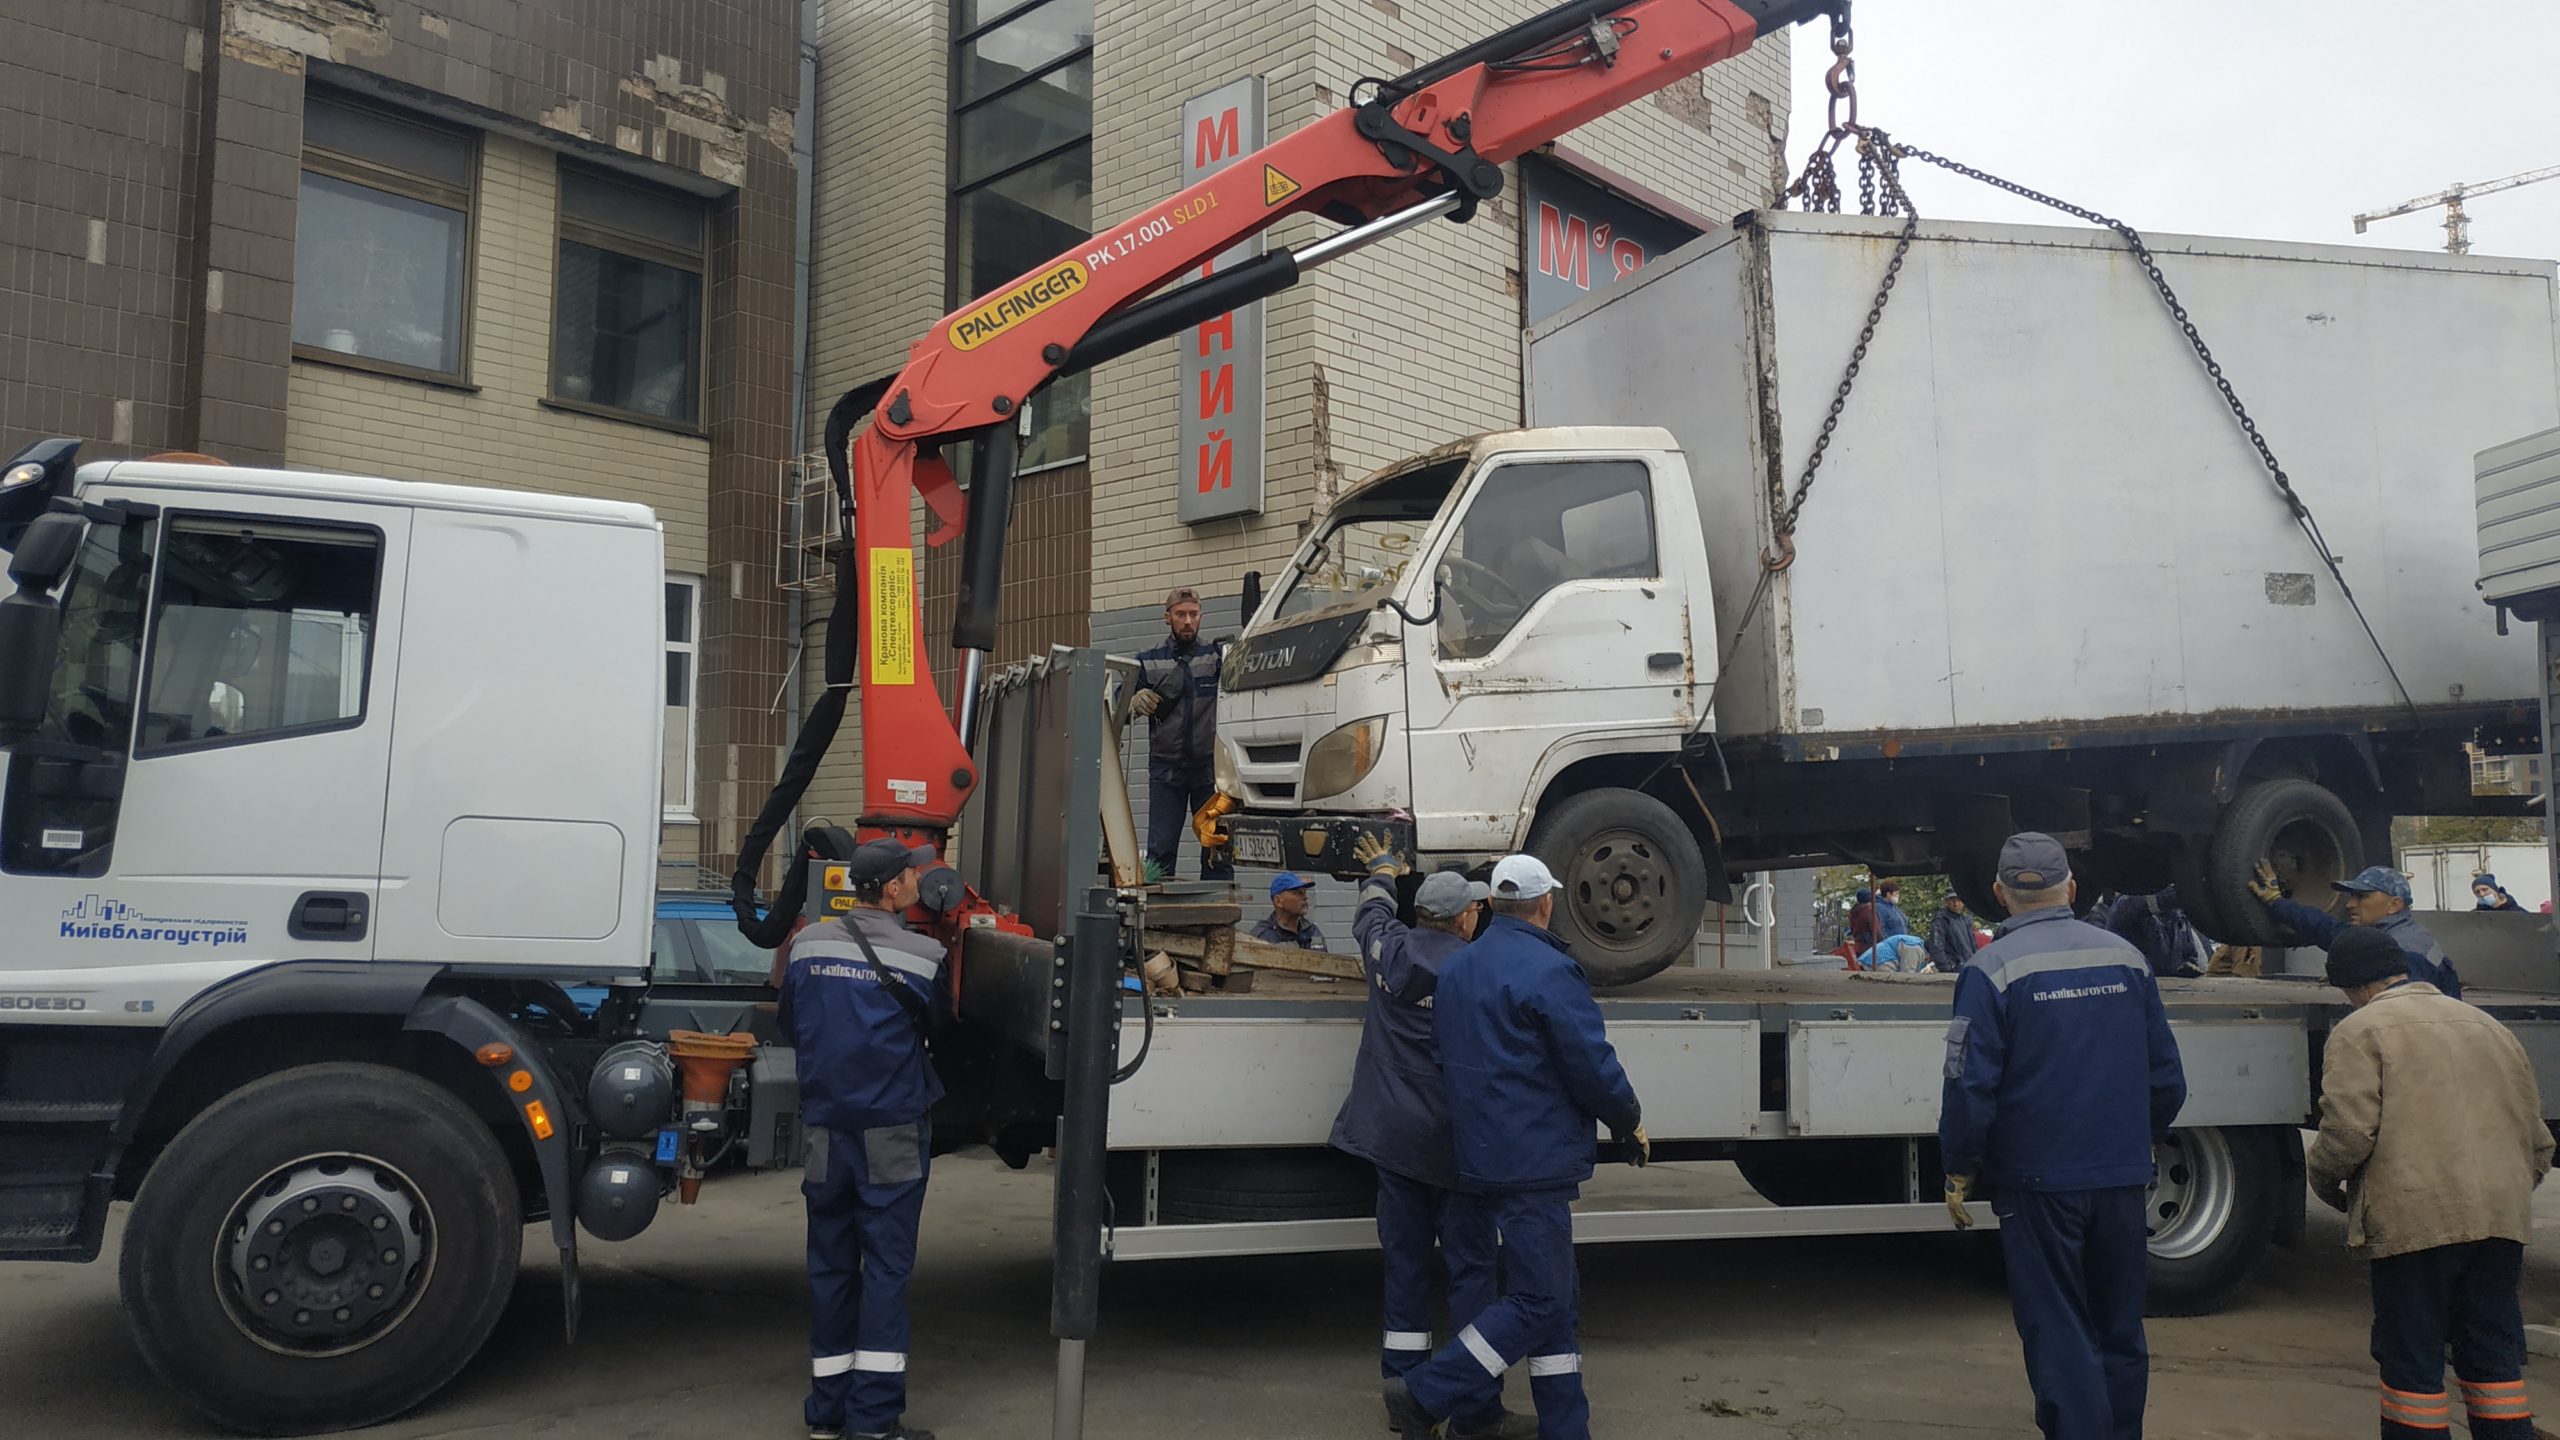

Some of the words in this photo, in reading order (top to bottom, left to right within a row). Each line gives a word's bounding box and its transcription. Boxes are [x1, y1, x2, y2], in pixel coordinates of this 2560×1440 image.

[1086, 246, 1116, 271] PK
[1114, 216, 1173, 256] 17.001
[1173, 191, 1219, 225] SLD1
[956, 266, 1082, 346] PALFINGER
[880, 565, 888, 615] компанія
[880, 619, 888, 666] Кранова
[1241, 646, 1296, 675] FOTON
[60, 922, 246, 946] Київблагоустрій
[2033, 991, 2047, 1002] КП
